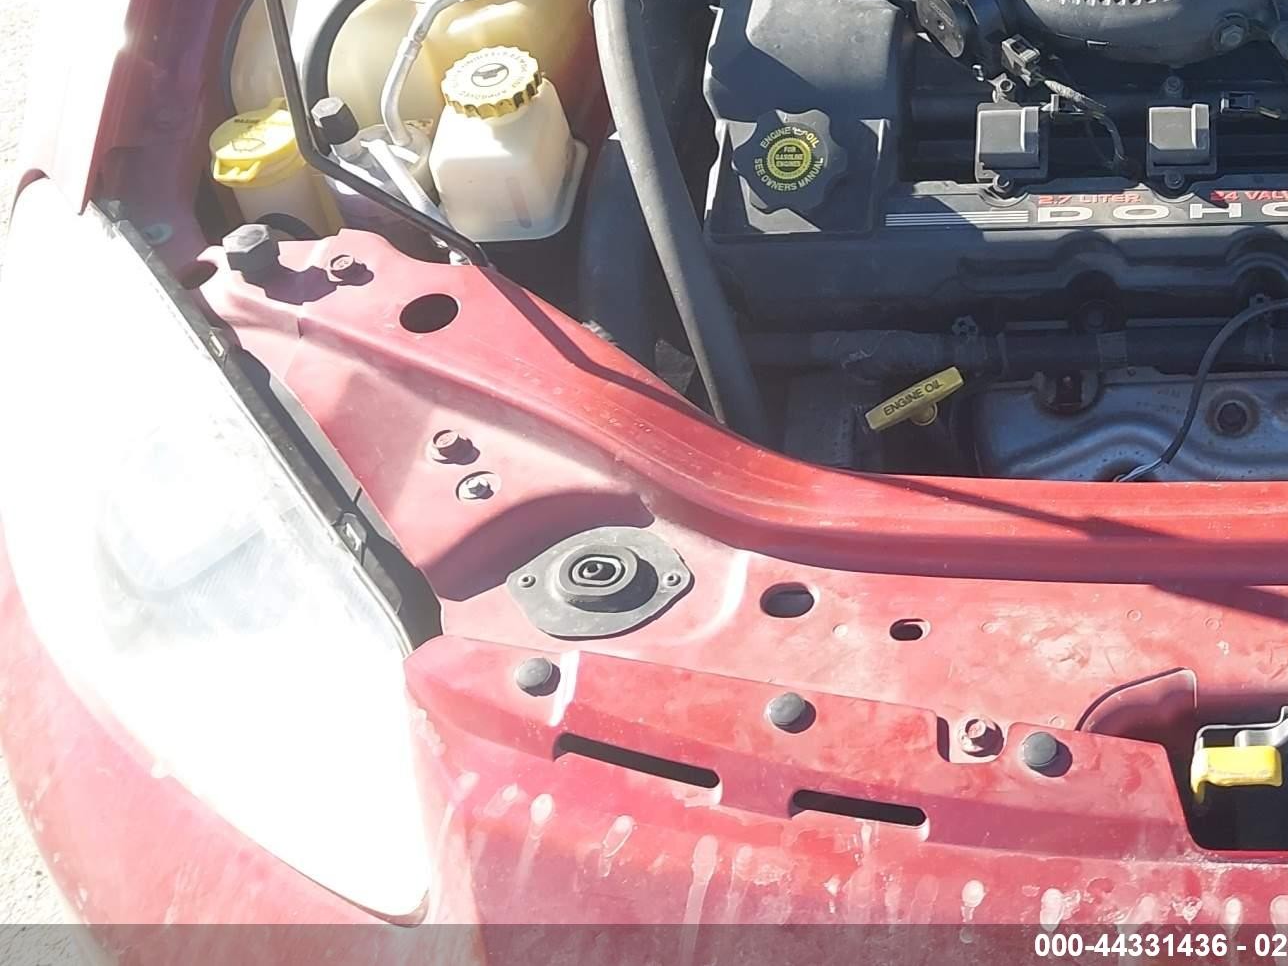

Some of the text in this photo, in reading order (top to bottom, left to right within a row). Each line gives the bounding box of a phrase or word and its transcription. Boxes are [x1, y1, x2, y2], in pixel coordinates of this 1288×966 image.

[760, 126, 820, 149] ENGINE OIL
[754, 158, 765, 176] SEE
[761, 175, 798, 191] OWNERS
[799, 157, 824, 188] MANUAL
[1038, 192, 1142, 205] 2.7 LITER
[1209, 189, 1240, 202] 24
[882, 379, 944, 416] ENGINE OIL
